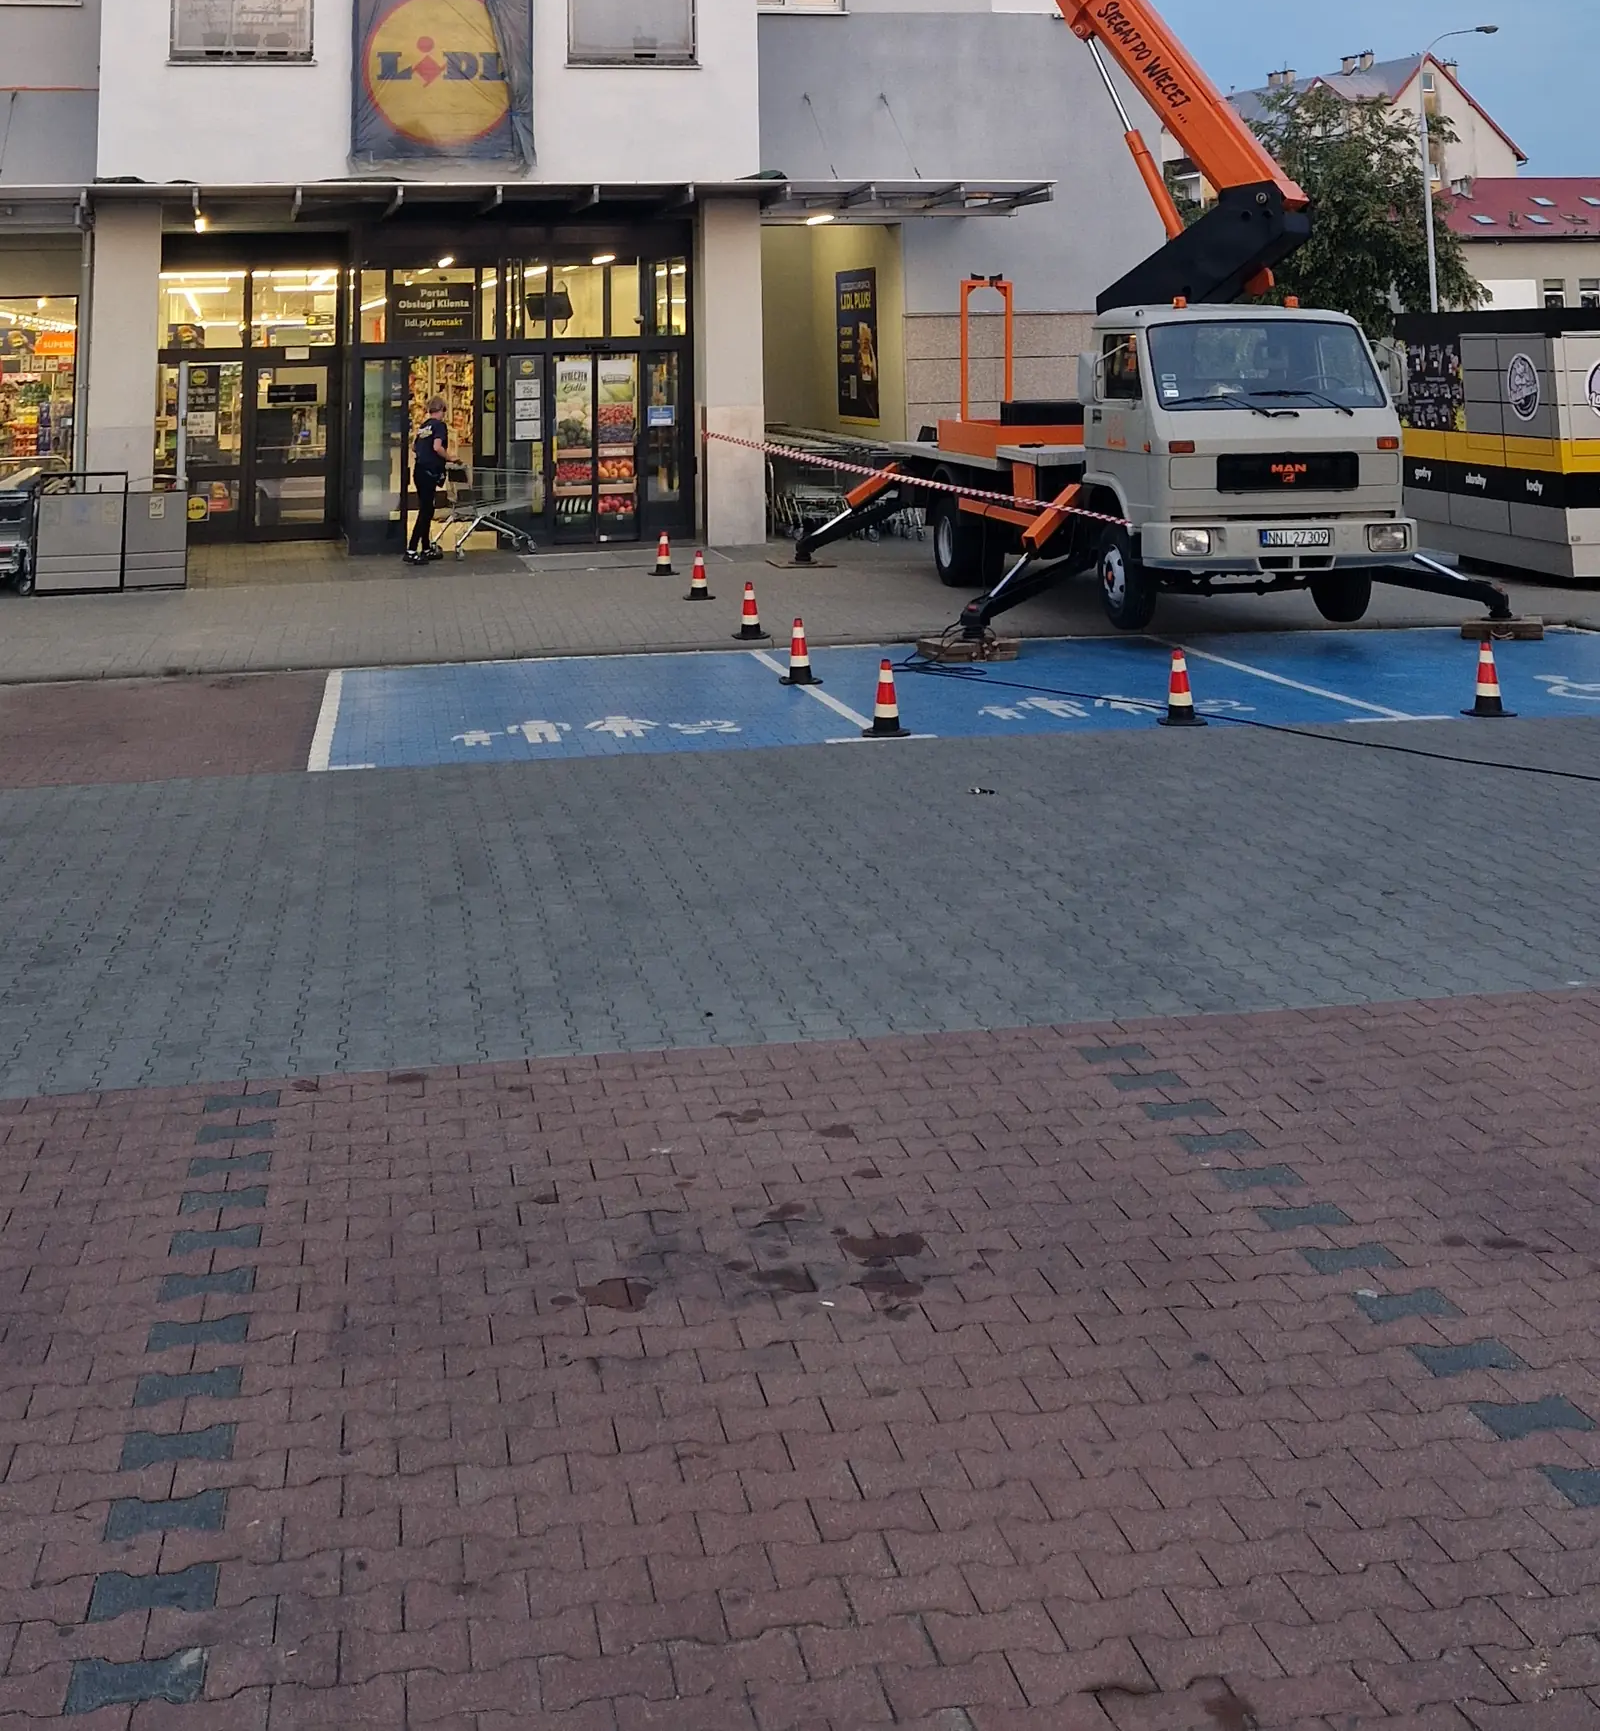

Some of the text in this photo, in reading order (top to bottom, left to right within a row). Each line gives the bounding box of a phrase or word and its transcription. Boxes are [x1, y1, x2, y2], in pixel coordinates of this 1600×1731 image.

[1128, 41, 1153, 61] PO
[420, 288, 449, 297] Portal
[398, 299, 469, 310] Obsługi Klienta
[840, 292, 854, 311] LIDL
[404, 318, 463, 328] lidl.pl/kontakt
[1271, 464, 1307, 473] MAN
[1414, 466, 1432, 482] gofry
[1526, 479, 1544, 496] lody
[1268, 531, 1328, 545] NNI 27309
